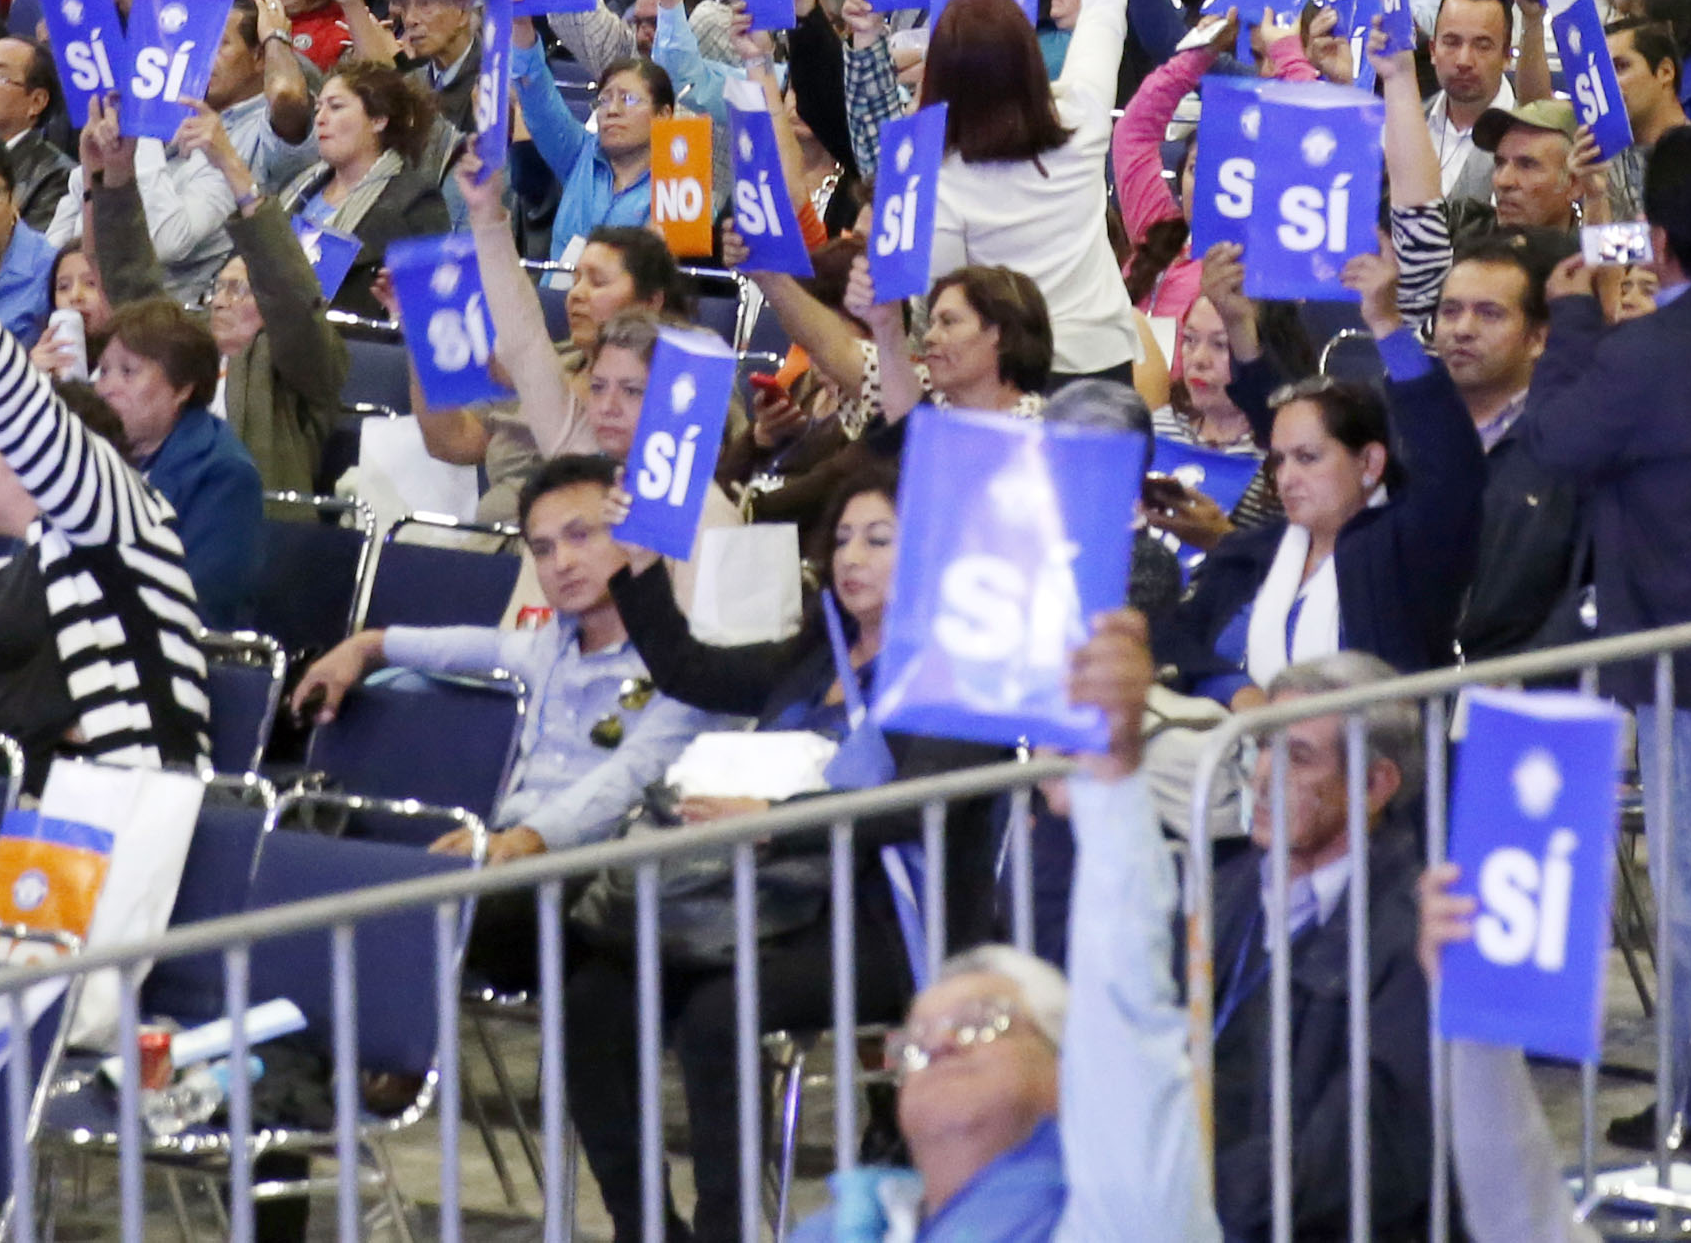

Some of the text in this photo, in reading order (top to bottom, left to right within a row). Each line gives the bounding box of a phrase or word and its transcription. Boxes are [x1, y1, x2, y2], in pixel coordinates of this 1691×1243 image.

[65, 28, 114, 90] SÍ
[132, 41, 195, 102] SÍ
[1575, 53, 1608, 135] SÍ
[656, 177, 703, 222] NO
[733, 171, 782, 236] SÍ
[877, 175, 920, 256] SÍ
[1278, 173, 1352, 252] SÍ
[637, 425, 701, 506] SÍ
[1474, 829, 1578, 970] SÍ
